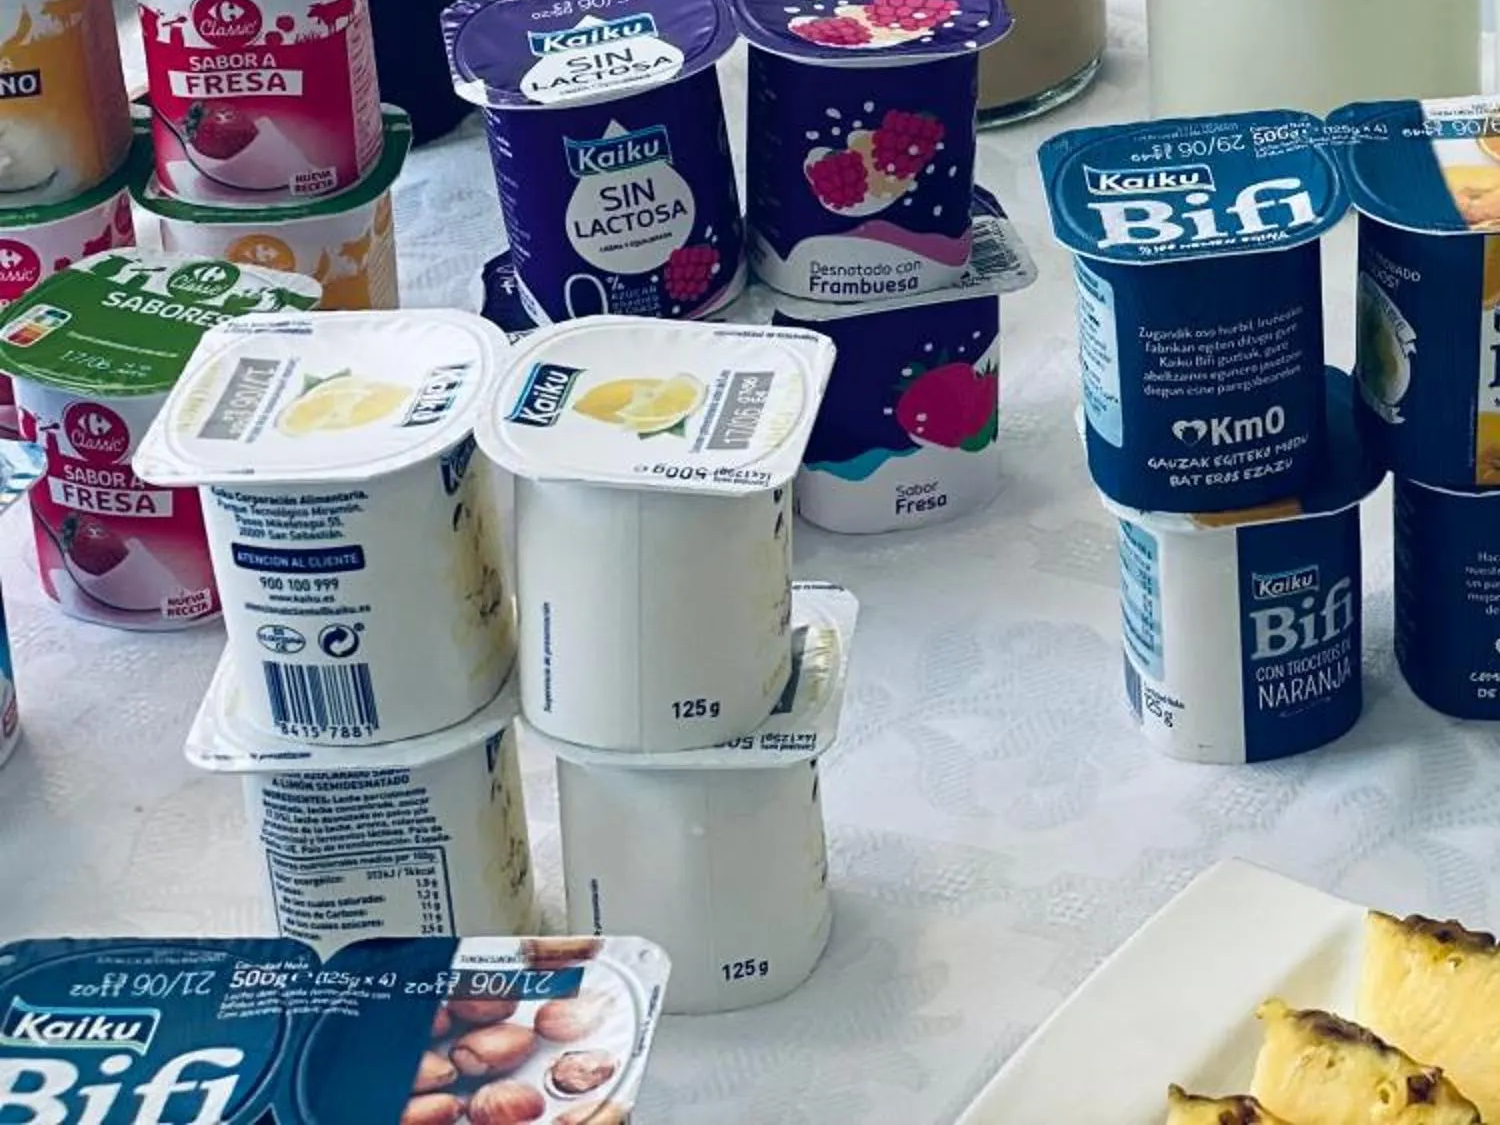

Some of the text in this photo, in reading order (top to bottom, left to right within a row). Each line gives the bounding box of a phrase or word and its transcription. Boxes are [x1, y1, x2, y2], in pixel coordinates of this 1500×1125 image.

[543, 20, 644, 52] Kaiku
[189, 53, 277, 72] SABOR A
[531, 55, 674, 92] LACTOSA
[567, 47, 634, 74] SIN
[187, 71, 288, 95] FRESA
[579, 137, 660, 172] Kaiku
[1179, 133, 1246, 159] 29/06
[1100, 173, 1199, 191] Kaiku
[600, 178, 655, 213] SIN
[574, 199, 688, 239] LACTOSA
[1087, 177, 1325, 249] Bifi
[810, 260, 922, 278] Desnatado con
[809, 276, 919, 296] Frambuesa
[523, 369, 570, 425] Kaiku
[63, 464, 125, 487] SABOR
[64, 489, 157, 515] FRESA
[895, 482, 939, 497] Sabor
[895, 493, 947, 515] Fresa
[291, 551, 358, 569] AL CLIENTE
[259, 576, 340, 592] 900 100 999
[1259, 573, 1315, 596] Kaiku
[1249, 576, 1354, 660] Bifi
[1255, 663, 1286, 682] CON
[130, 970, 217, 999] 21/06
[229, 970, 290, 988] 500g
[469, 969, 555, 996] 21/06
[11, 1008, 143, 1044] Kaiku
[0, 1047, 246, 1125] Bifi
